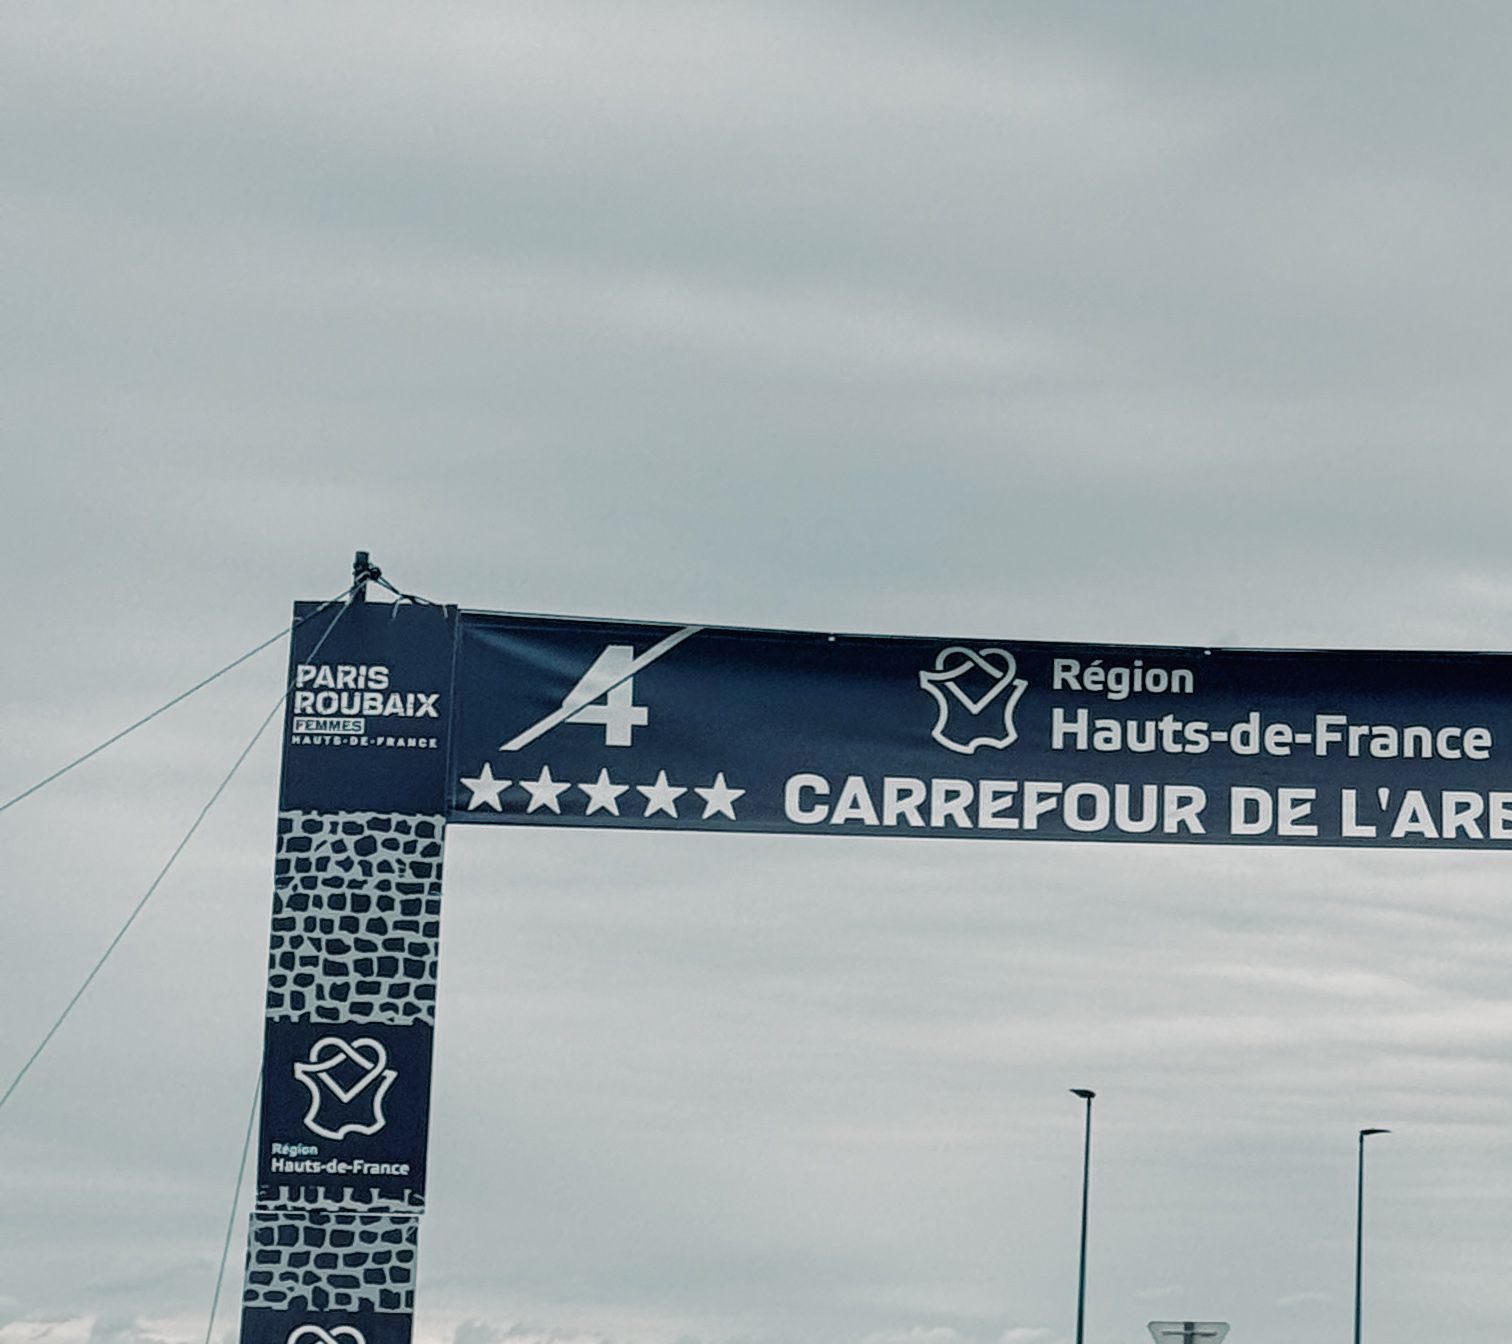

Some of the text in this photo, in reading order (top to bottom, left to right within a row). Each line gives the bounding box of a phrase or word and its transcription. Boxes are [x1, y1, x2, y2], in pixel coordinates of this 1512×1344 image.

[296, 664, 390, 690] PARIS
[1053, 658, 1194, 701] Région
[294, 690, 440, 718] ROUBAIX
[295, 719, 363, 732] FEMMES
[1052, 707, 1492, 760] Hauts-de-France
[784, 773, 1208, 835] CARREFOUR
[1230, 786, 1319, 837] DE
[271, 1142, 319, 1157] Région
[271, 1158, 410, 1176] Hauts-de-France
